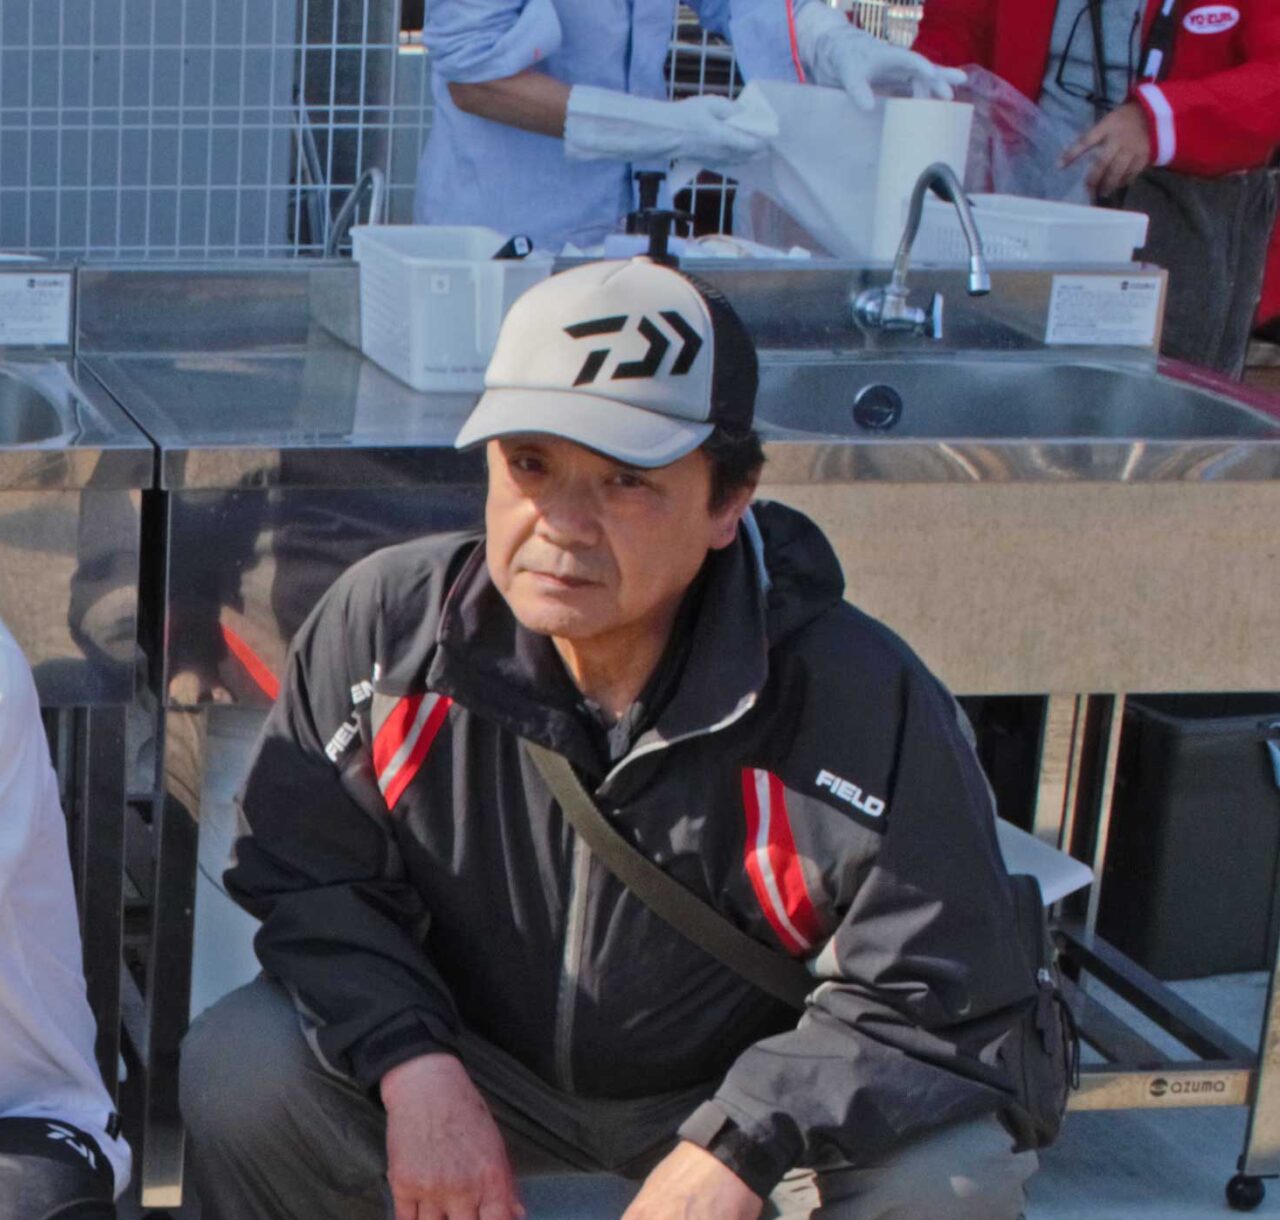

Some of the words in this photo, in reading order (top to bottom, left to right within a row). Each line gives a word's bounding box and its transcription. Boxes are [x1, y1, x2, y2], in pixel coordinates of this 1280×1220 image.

[324, 709, 361, 763] FIEL
[815, 769, 886, 818] FIELD
[1170, 1079, 1226, 1094] azuma
